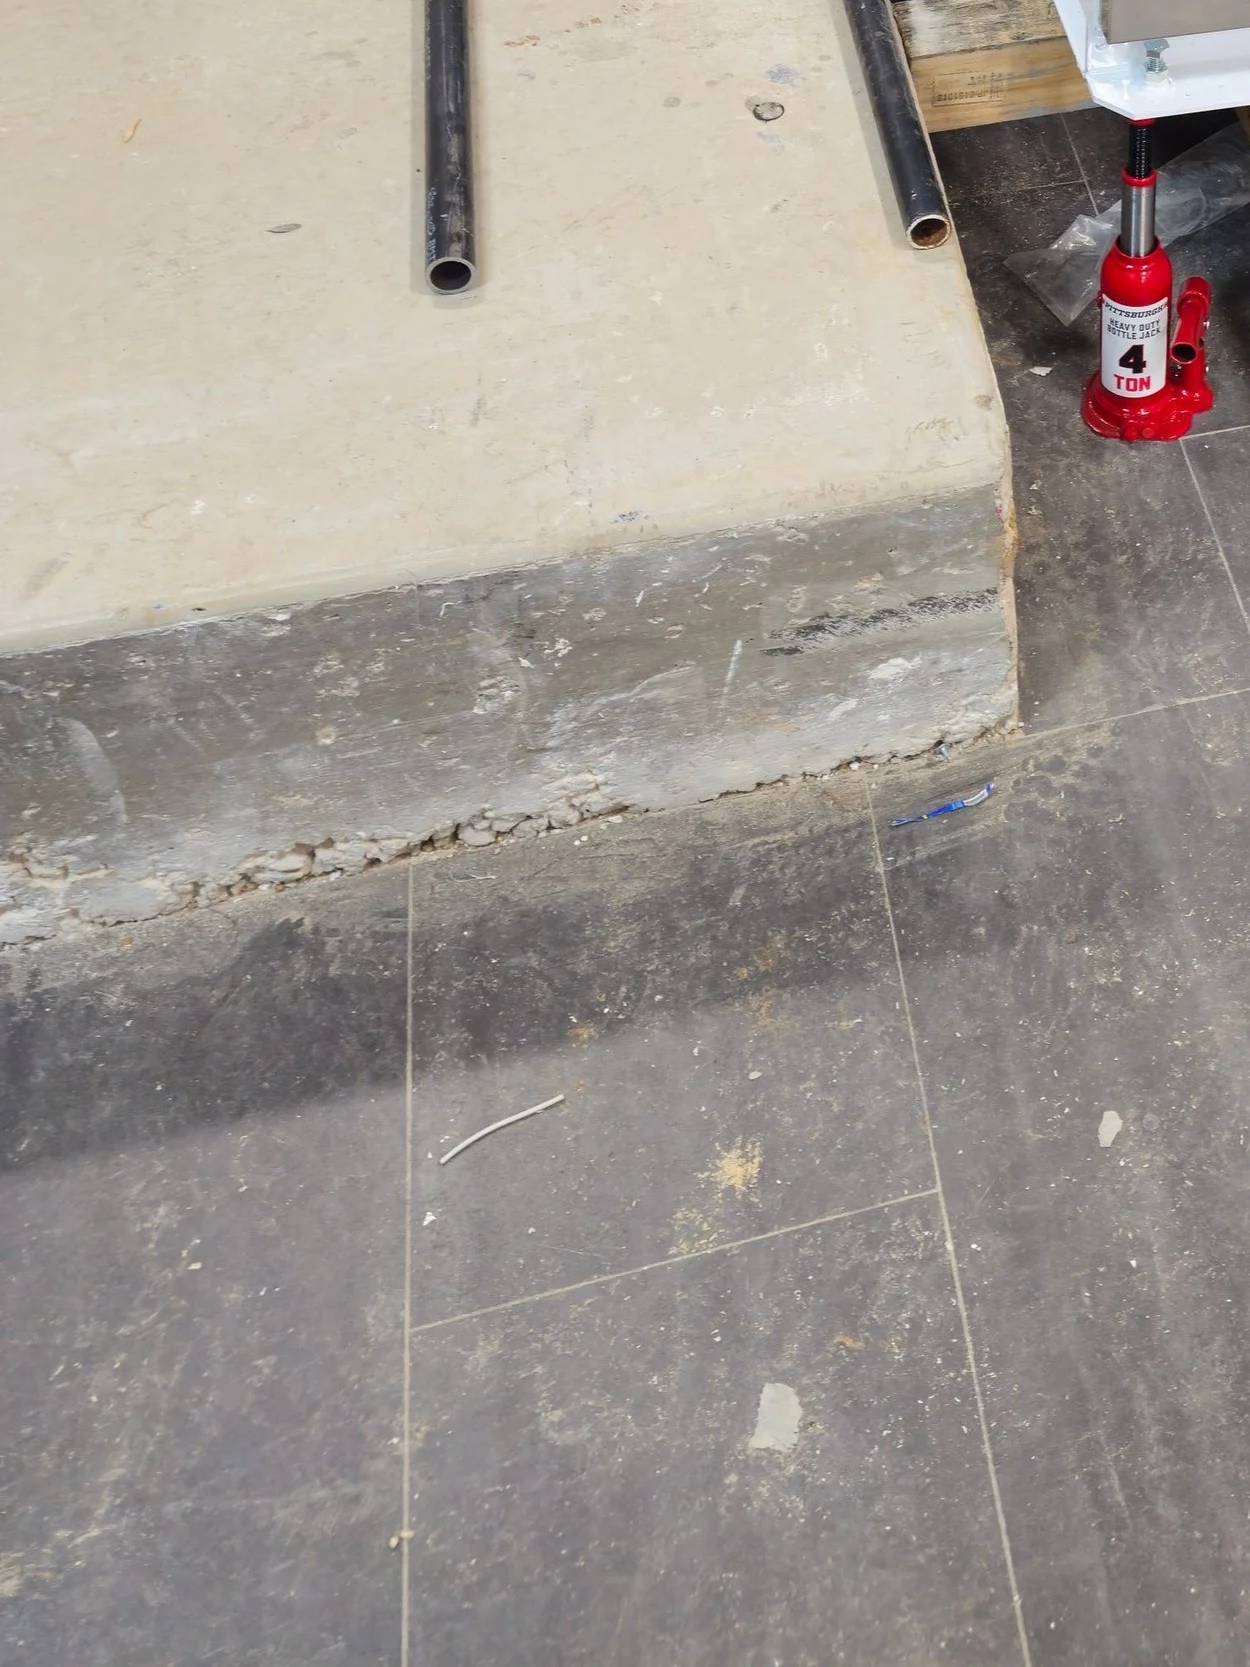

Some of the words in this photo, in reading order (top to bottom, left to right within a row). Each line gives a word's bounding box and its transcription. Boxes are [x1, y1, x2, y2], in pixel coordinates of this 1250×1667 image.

[1104, 302, 1164, 319] PITTSBURGH
[1107, 324, 1137, 340] BOTTLE
[1139, 327, 1161, 340] JACK
[1109, 318, 1136, 332] HEAVY
[1138, 318, 1161, 332] DUTY
[1118, 343, 1147, 374] 4
[1113, 373, 1151, 392] TON
